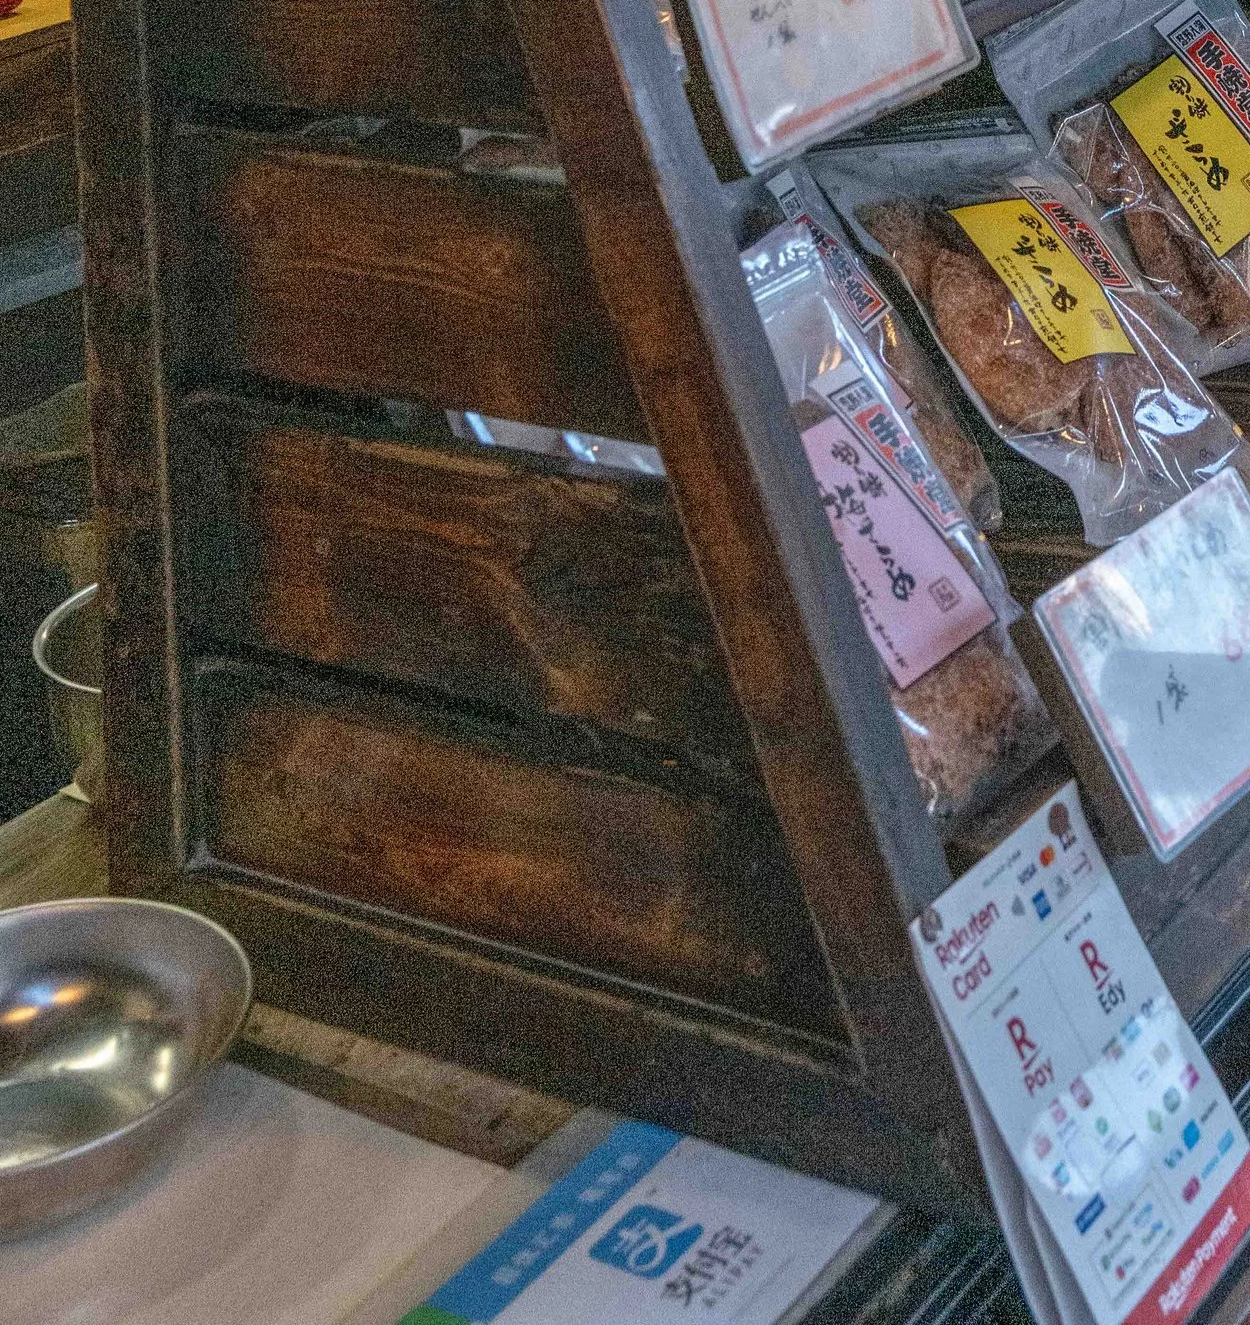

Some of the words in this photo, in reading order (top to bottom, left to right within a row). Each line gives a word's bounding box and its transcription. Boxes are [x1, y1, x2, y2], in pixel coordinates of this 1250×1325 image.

[1164, 107, 1230, 192] ざらめ
[1011, 234, 1079, 314] ざらめ
[1051, 206, 1121, 281] 手焼堂
[867, 412, 957, 517] 手焼堂
[931, 900, 1002, 971] Rakuten
[948, 950, 995, 1003] Card
[1095, 979, 1131, 1015] Edy
[1020, 1057, 1060, 1098] Pay
[660, 1220, 753, 1311] 支付宝
[1154, 1258, 1204, 1318] Rakuten
[1193, 1204, 1240, 1264] Payment
